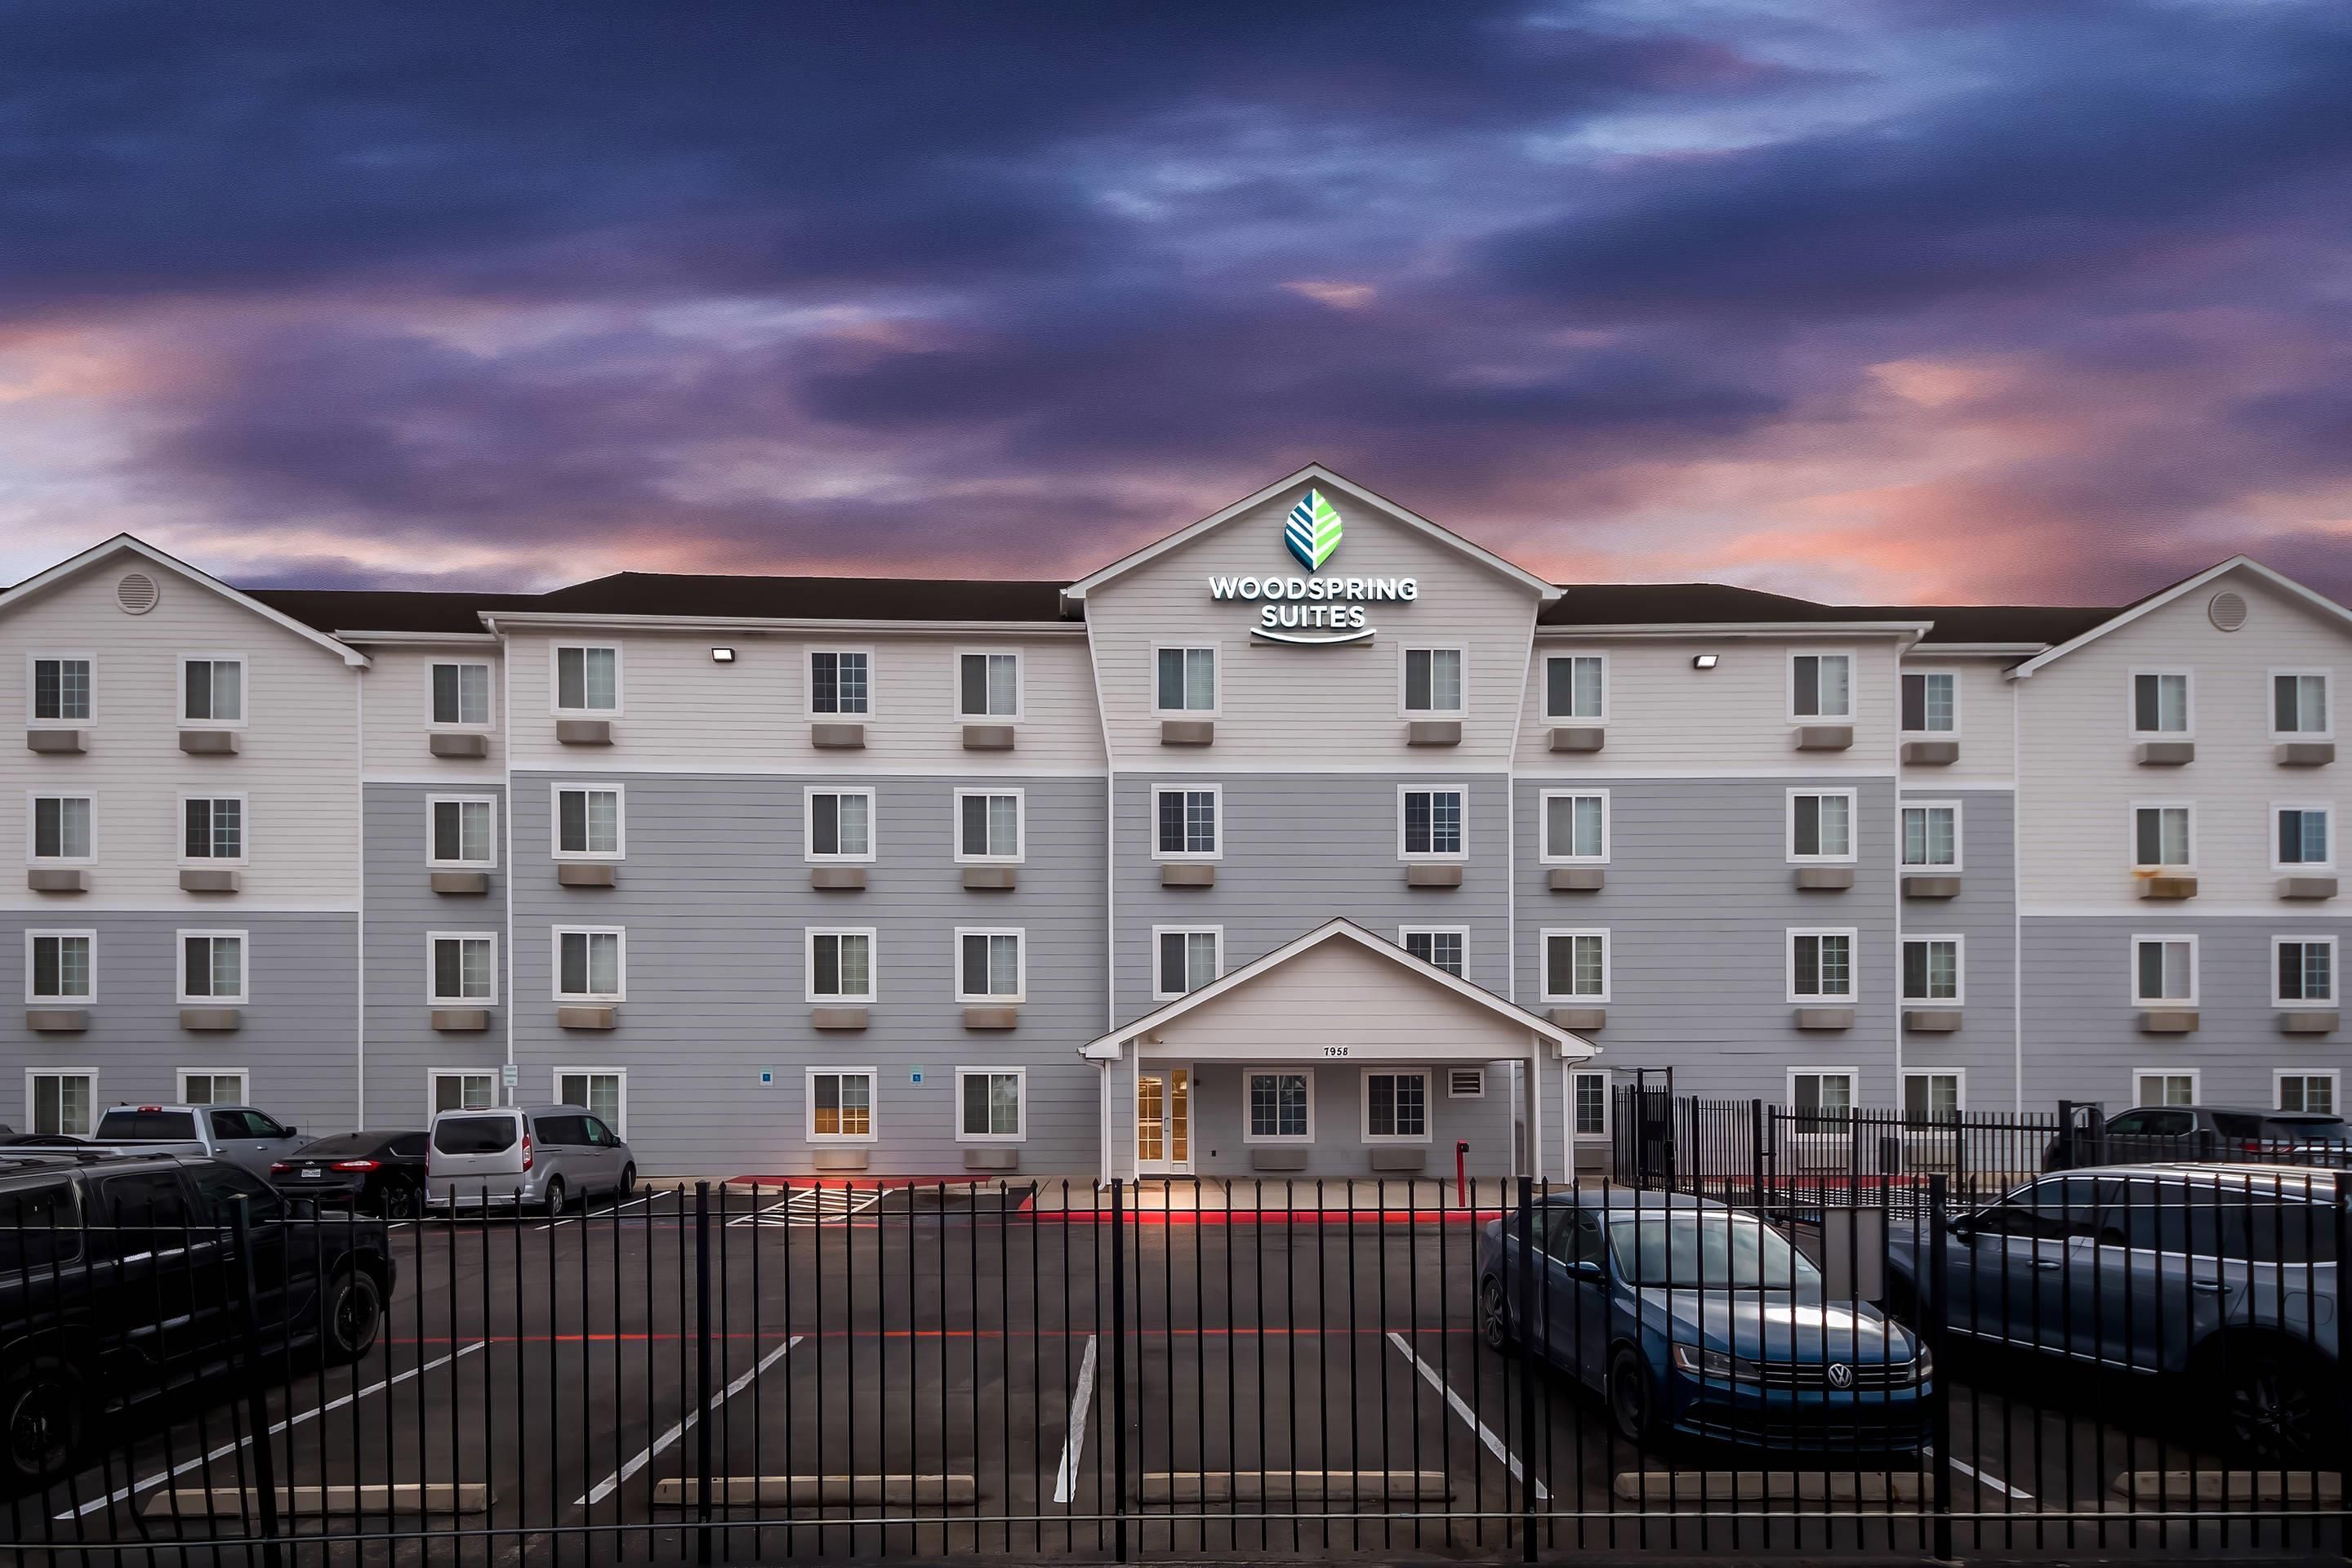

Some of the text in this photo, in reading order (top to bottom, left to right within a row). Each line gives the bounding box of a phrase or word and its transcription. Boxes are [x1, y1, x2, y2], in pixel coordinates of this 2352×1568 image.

[1208, 576, 1418, 601] WOODSPRING
[1261, 604, 1366, 629] SUITES
[1323, 1046, 1349, 1057] 7958
